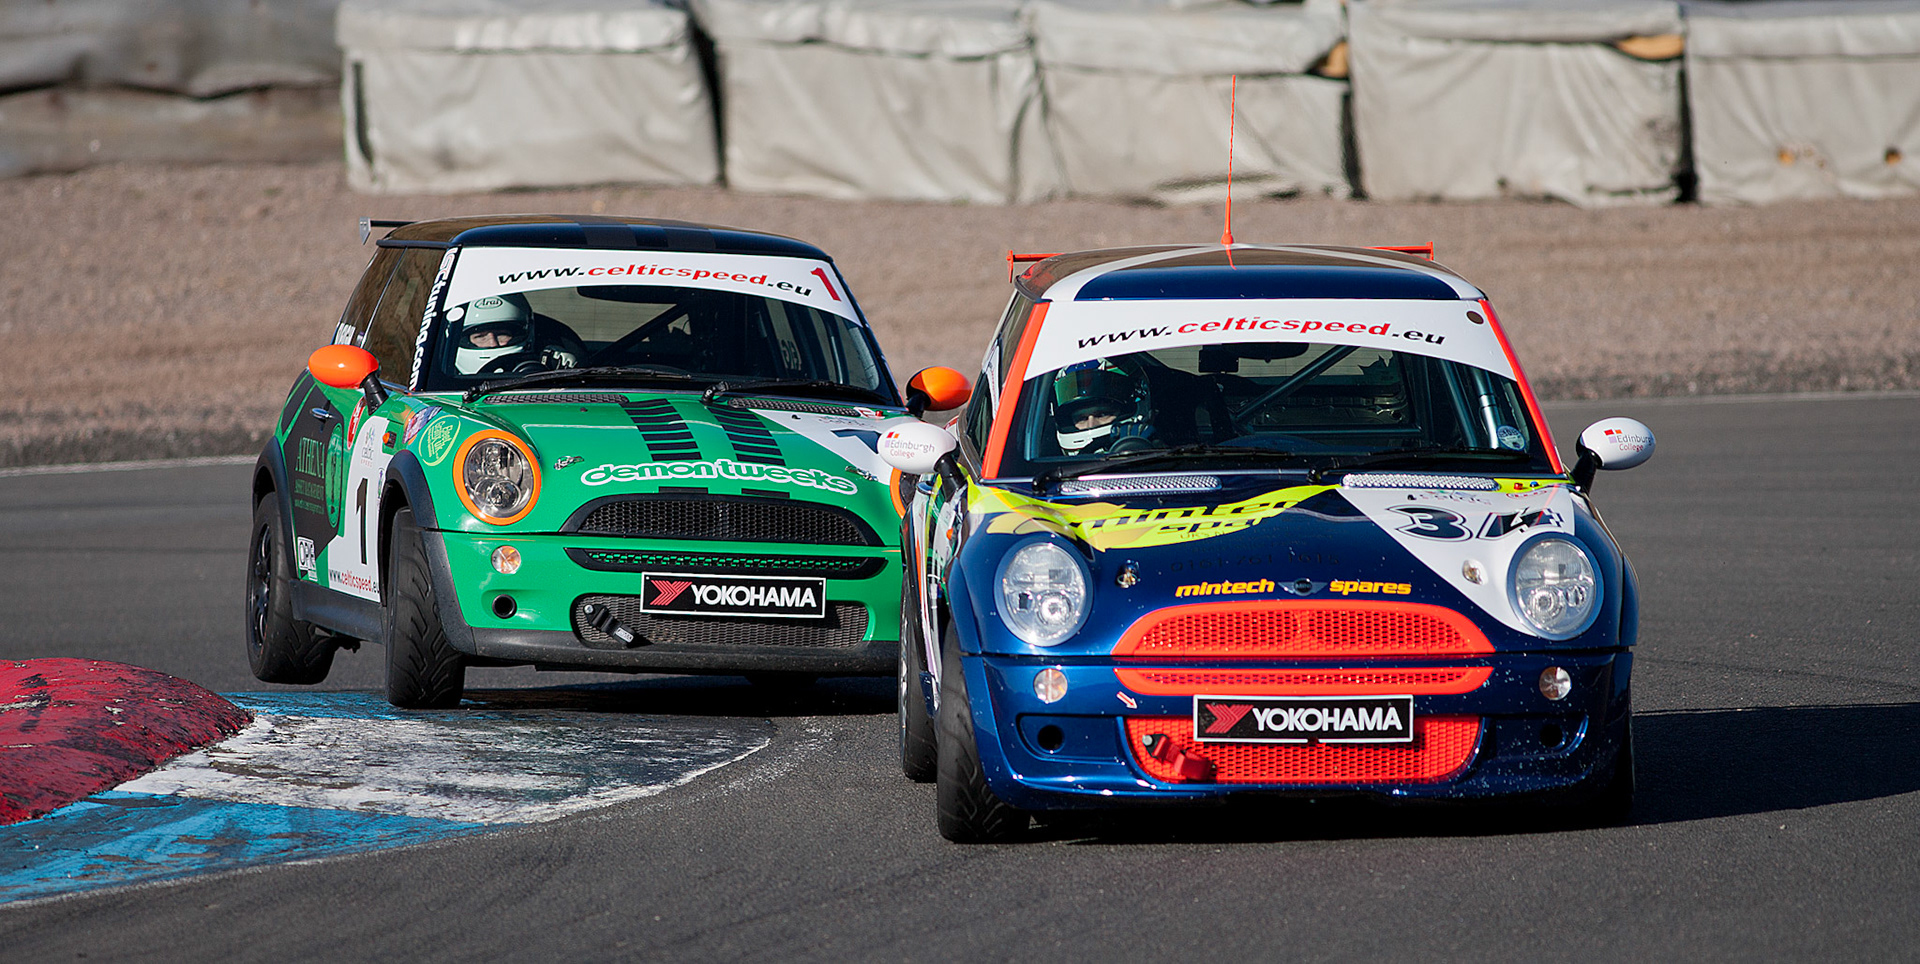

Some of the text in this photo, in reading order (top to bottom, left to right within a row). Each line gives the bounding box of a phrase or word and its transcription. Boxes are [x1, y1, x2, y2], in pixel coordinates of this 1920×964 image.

[499, 263, 812, 297] www.celticspeed.eu
[811, 267, 842, 302] 1
[1078, 316, 1446, 349] www.celticspeed.eu
[295, 436, 325, 479] ATHENA
[890, 439, 936, 454] Edinburgh
[890, 448, 916, 459] College
[581, 459, 858, 496] demon tweeks
[355, 477, 368, 566] 1
[691, 584, 818, 608] YOKOHAMA
[1175, 578, 1276, 598] mintech
[1329, 579, 1412, 596] spares
[1251, 706, 1403, 732] YOKOHAMA
